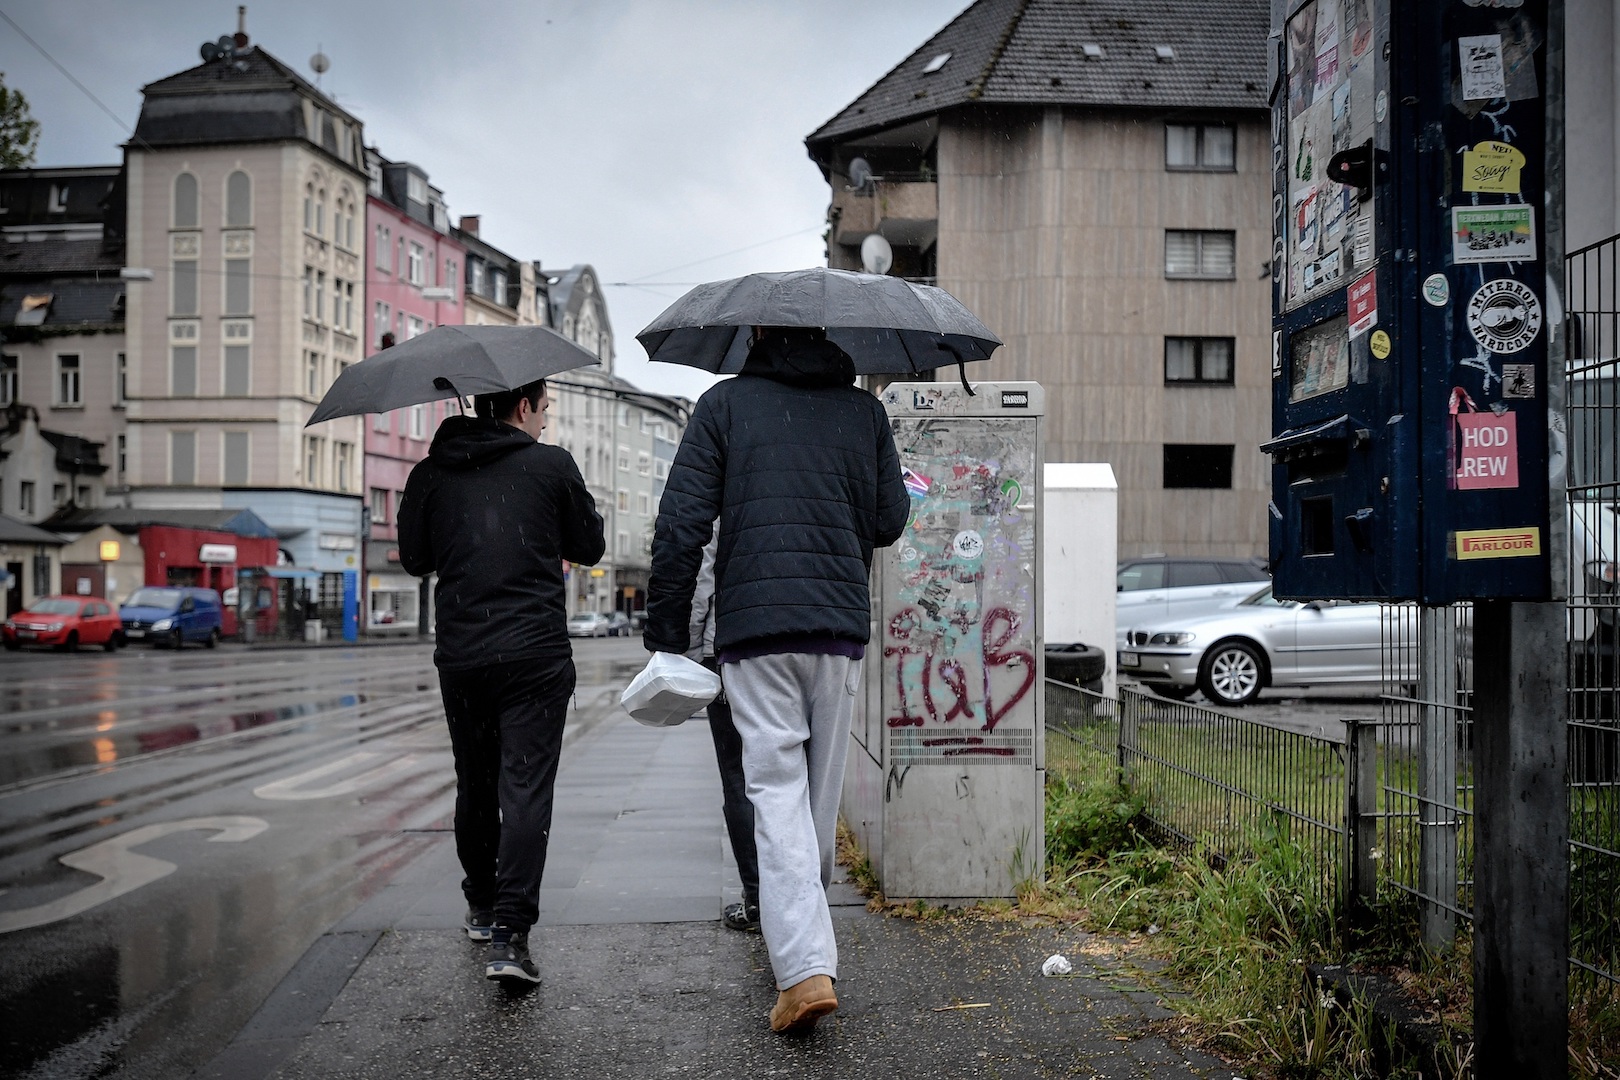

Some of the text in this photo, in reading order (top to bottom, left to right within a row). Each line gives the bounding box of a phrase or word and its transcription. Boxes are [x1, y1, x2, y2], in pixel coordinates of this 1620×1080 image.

[1472, 282, 1537, 309] MYTERROR
[1473, 325, 1537, 351] HARDCORE
[1456, 456, 1508, 477] REW
